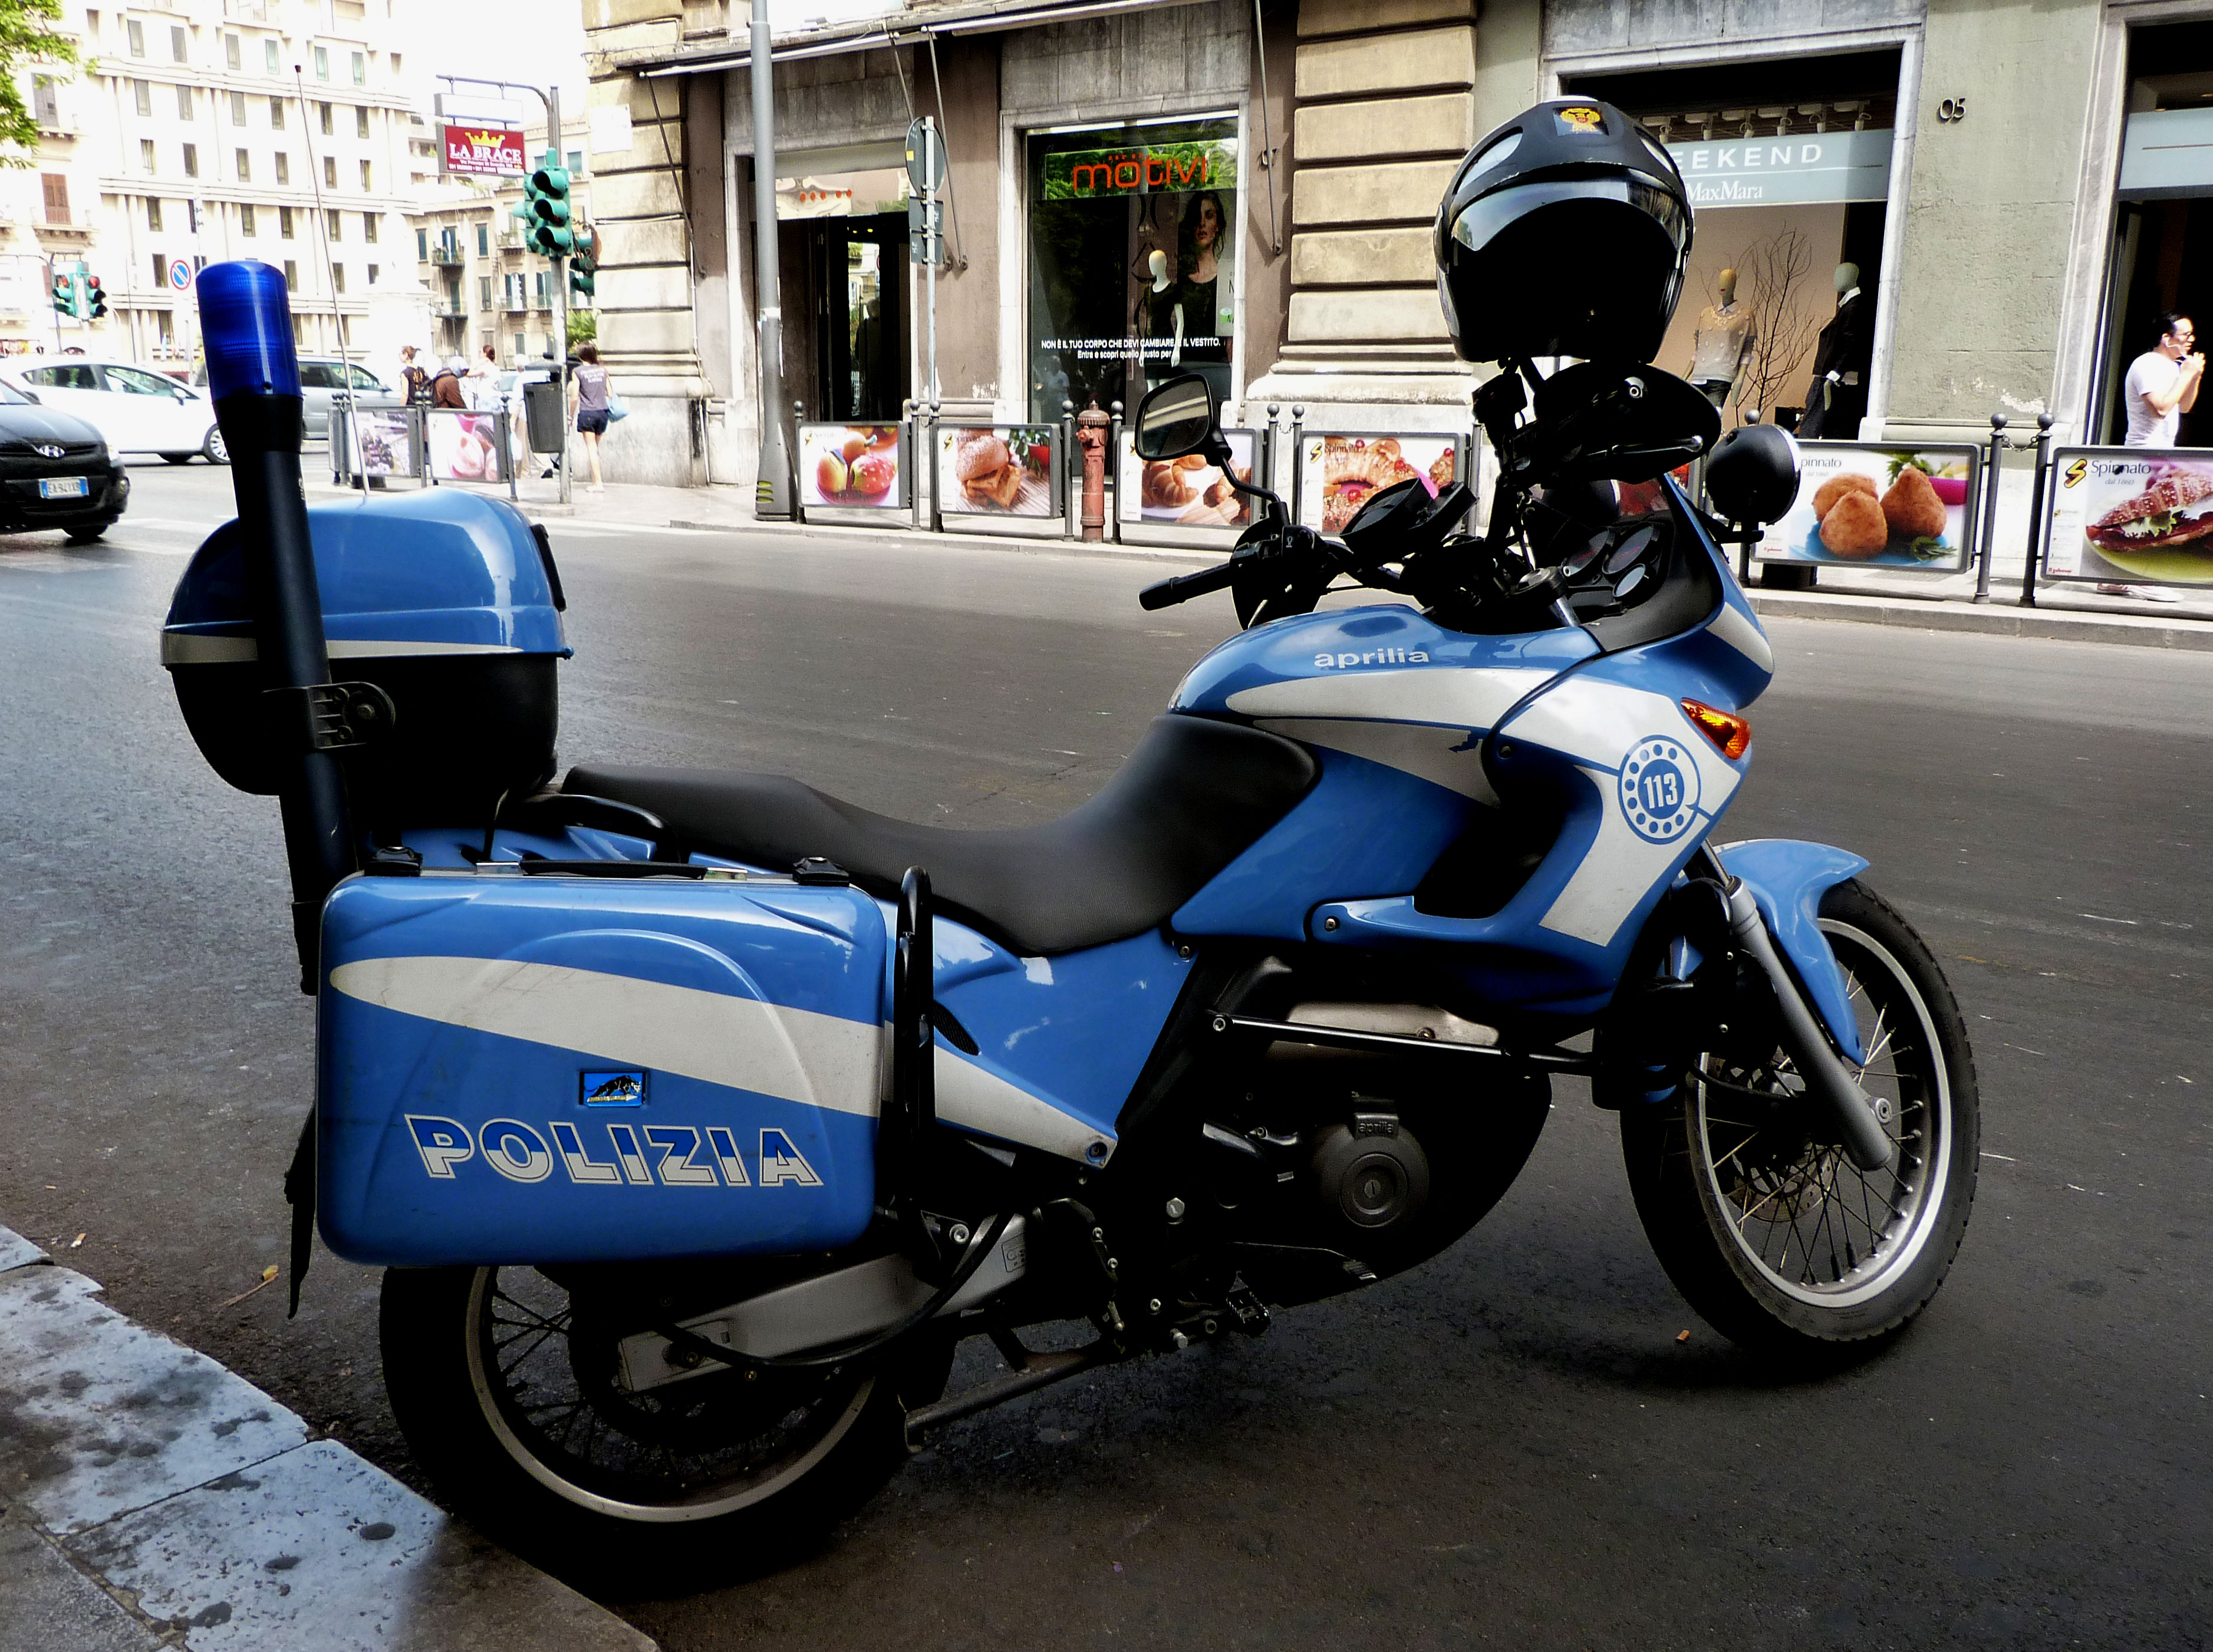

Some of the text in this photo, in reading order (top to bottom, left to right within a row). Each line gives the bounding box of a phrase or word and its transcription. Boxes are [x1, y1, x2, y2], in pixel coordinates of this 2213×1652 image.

[449, 143, 522, 162] LA BRACE
[1671, 144, 1822, 170] EEKEND
[1685, 180, 1763, 202] MaxMara
[1041, 339, 1056, 349] NON
[1069, 339, 1083, 349] TUO
[1084, 339, 1108, 349] CORPO
[1108, 339, 1122, 348] CHE
[1124, 338, 1139, 348] DEVI
[1183, 338, 1189, 347] IL
[1190, 337, 1220, 347] VESTITO.
[1077, 349, 1094, 359] Entra
[1100, 349, 1119, 360] scopri
[1119, 349, 1139, 360] quello
[1144, 349, 1160, 358] iusto
[1800, 456, 1842, 470] pinnato
[1313, 648, 1430, 669] aprilia
[1644, 773, 1678, 809] 113
[1359, 1120, 1394, 1136] aprilia
[405, 1113, 825, 1187] POLIZIA
